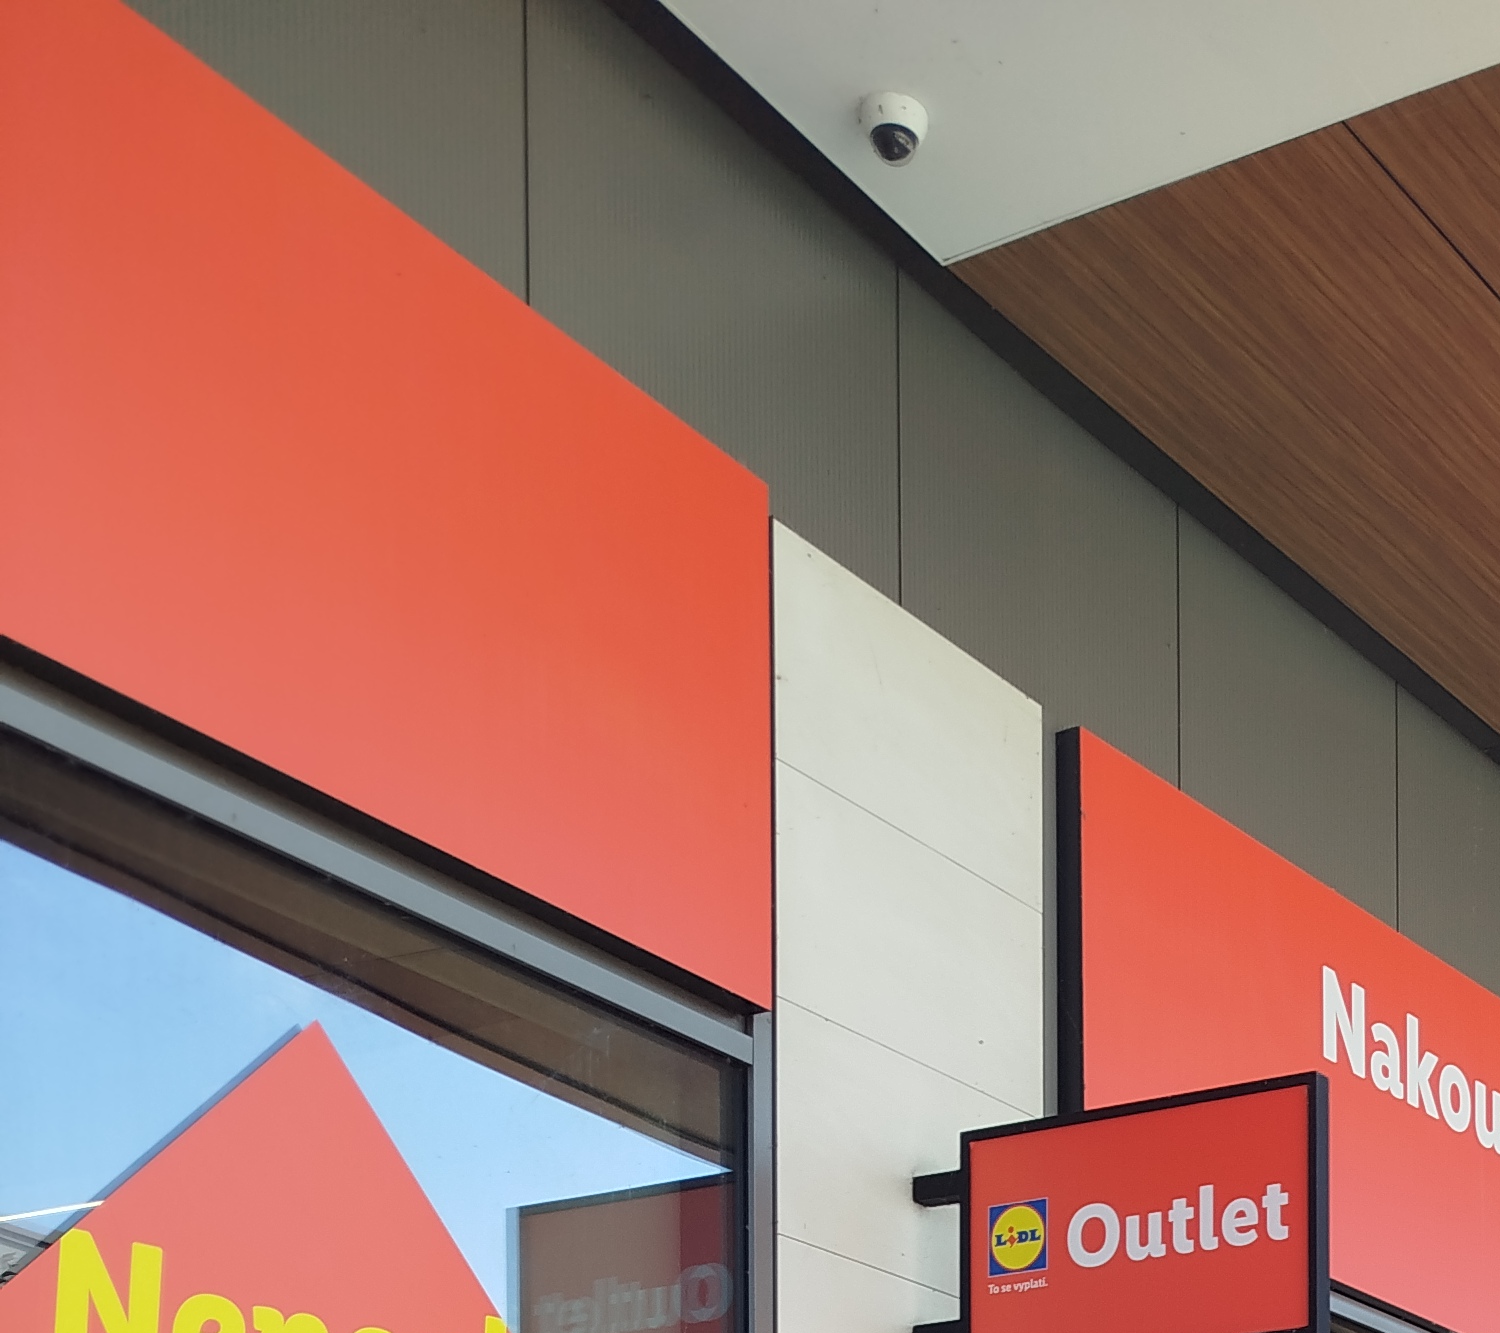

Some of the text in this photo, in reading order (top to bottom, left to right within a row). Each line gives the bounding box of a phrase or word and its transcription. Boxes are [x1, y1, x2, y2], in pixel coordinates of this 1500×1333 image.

[1066, 1183, 1290, 1268] Outlet
[988, 1283, 1000, 1295] To
[1000, 1283, 1012, 1294] se
